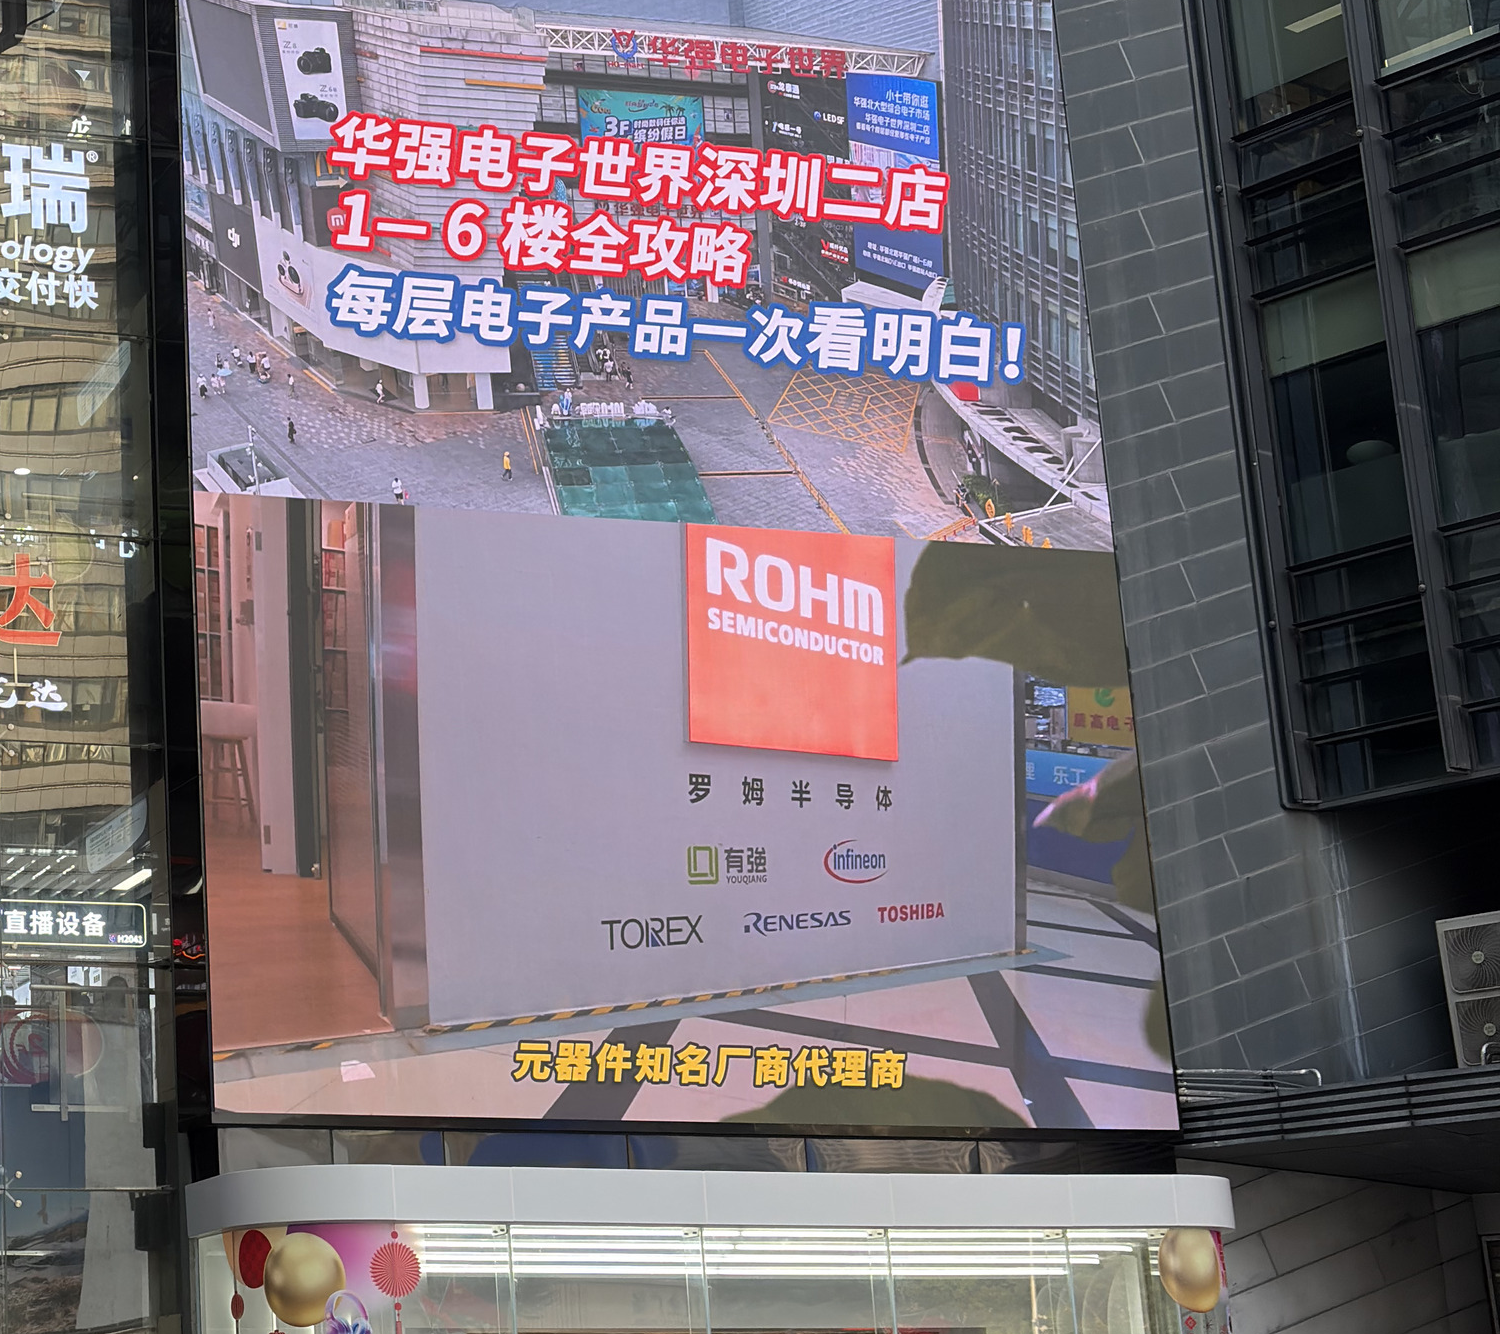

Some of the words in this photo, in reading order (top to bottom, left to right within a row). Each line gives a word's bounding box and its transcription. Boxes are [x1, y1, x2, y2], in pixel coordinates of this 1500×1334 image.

[649, 35, 847, 80] 华强电子世界
[604, 117, 629, 137] 3F
[332, 114, 947, 230] 华强电子世界深圳二店
[706, 536, 885, 637] ROHM
[707, 607, 885, 666] SEMICONDUCTOR
[688, 772, 893, 812] 罗姆半导体
[725, 873, 768, 885] YOUQIANG
[3, 910, 106, 938] 直播设备
[601, 914, 704, 951] TOREX
[743, 910, 852, 937] RENESAS
[877, 902, 946, 924] TOSHIBA
[512, 1041, 907, 1089] 元器件知名厂商代理商
